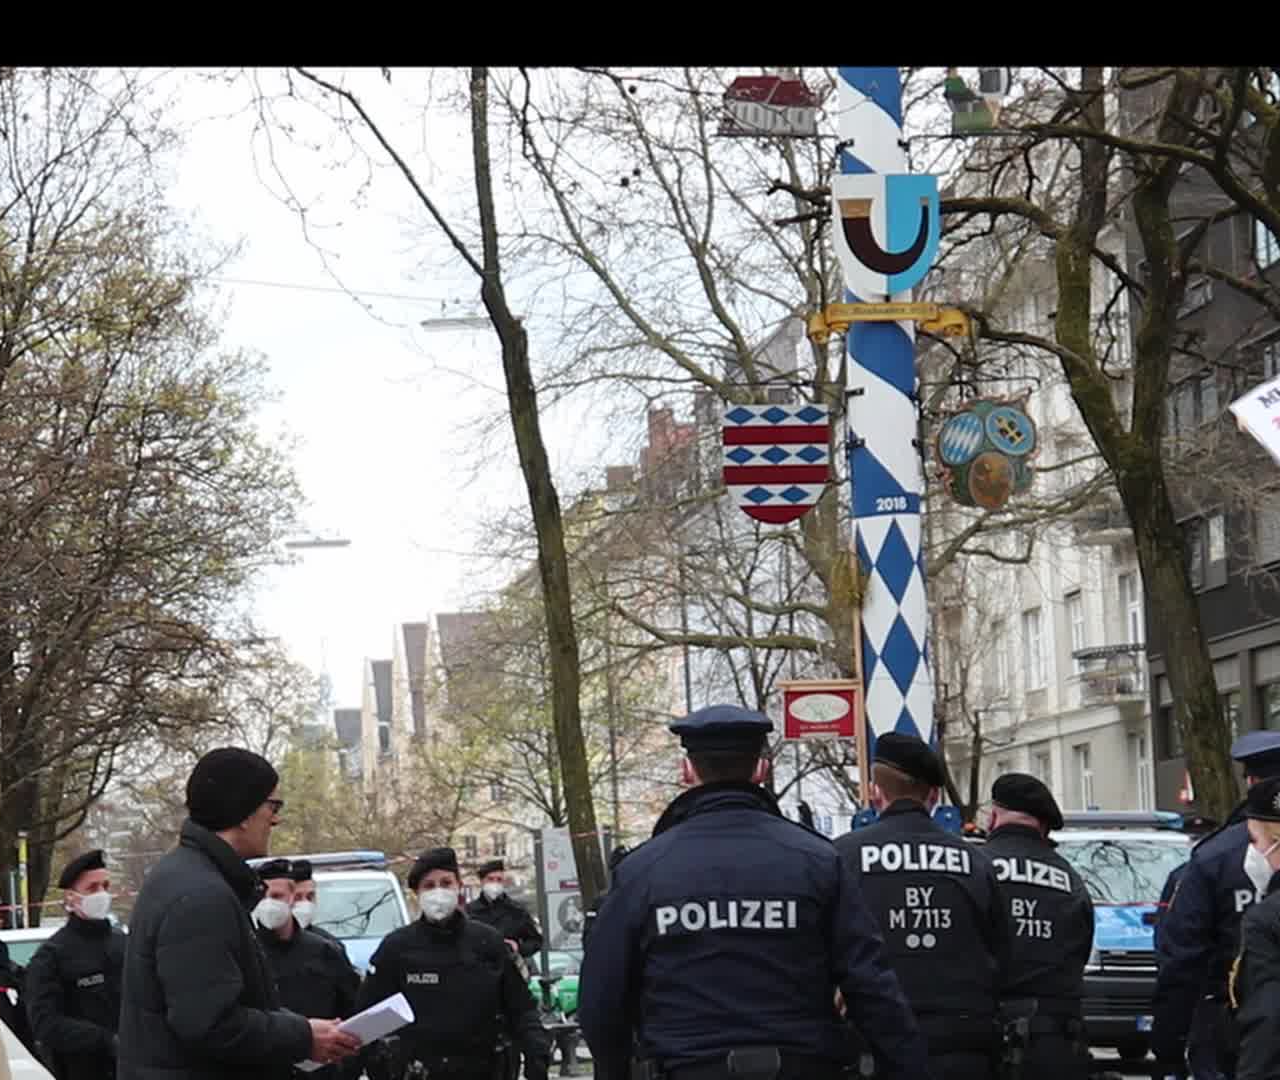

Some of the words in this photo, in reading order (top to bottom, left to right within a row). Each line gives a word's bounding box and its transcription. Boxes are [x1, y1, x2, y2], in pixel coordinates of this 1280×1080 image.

[876, 496, 907, 512] 2018
[861, 844, 970, 874] POLIZEI
[905, 887, 934, 907] BY
[656, 901, 797, 934] POLIZEI
[1011, 898, 1038, 917] BY
[888, 909, 905, 929] M
[912, 909, 952, 929] 7113
[1016, 918, 1053, 939] 7113
